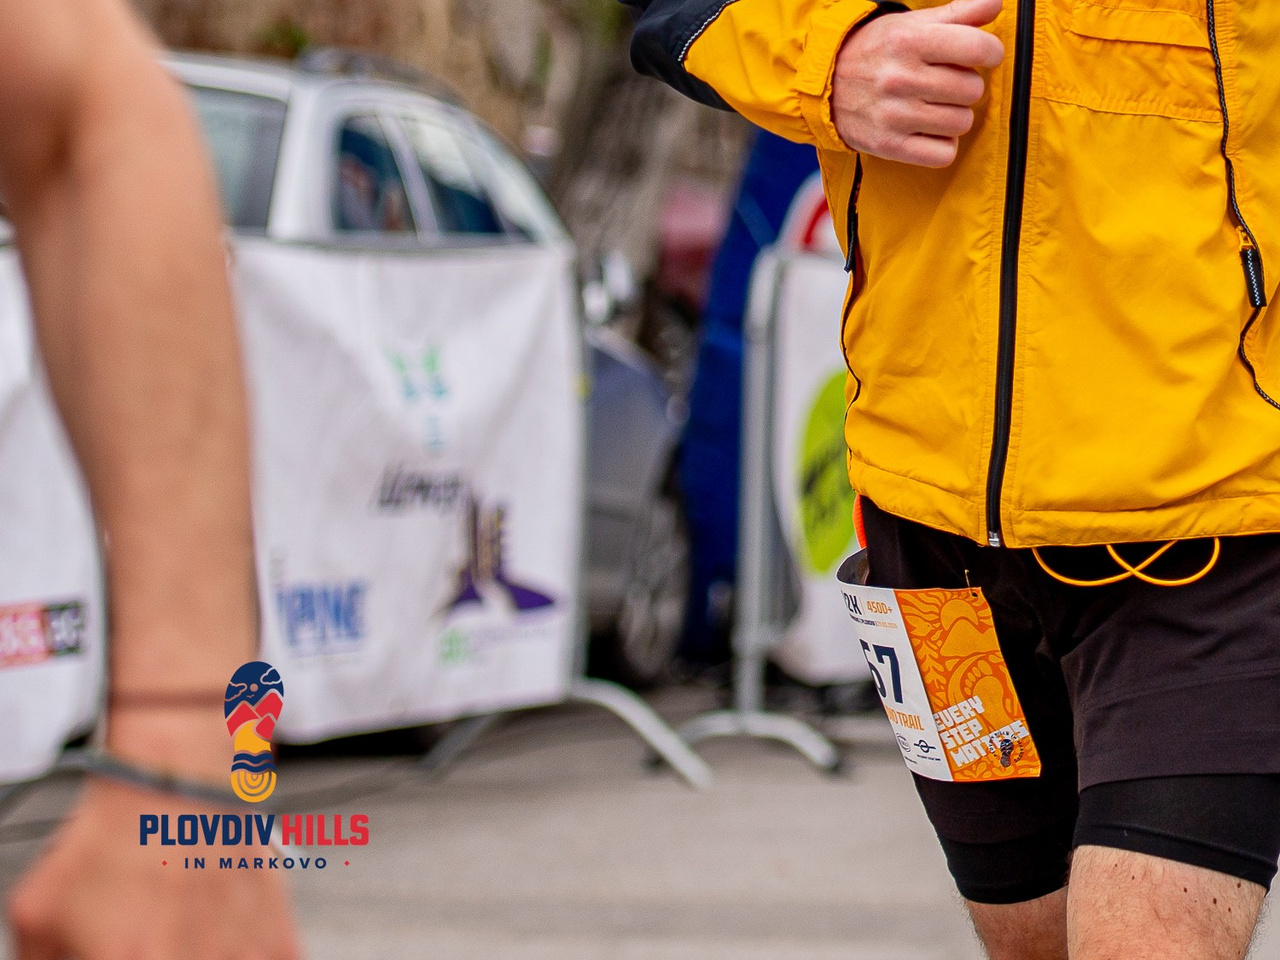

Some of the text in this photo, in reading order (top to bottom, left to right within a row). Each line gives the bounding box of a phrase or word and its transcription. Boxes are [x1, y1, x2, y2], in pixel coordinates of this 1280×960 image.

[842, 591, 862, 616] 2K
[896, 711, 925, 731] TRAIL
[940, 718, 983, 749] STEP
